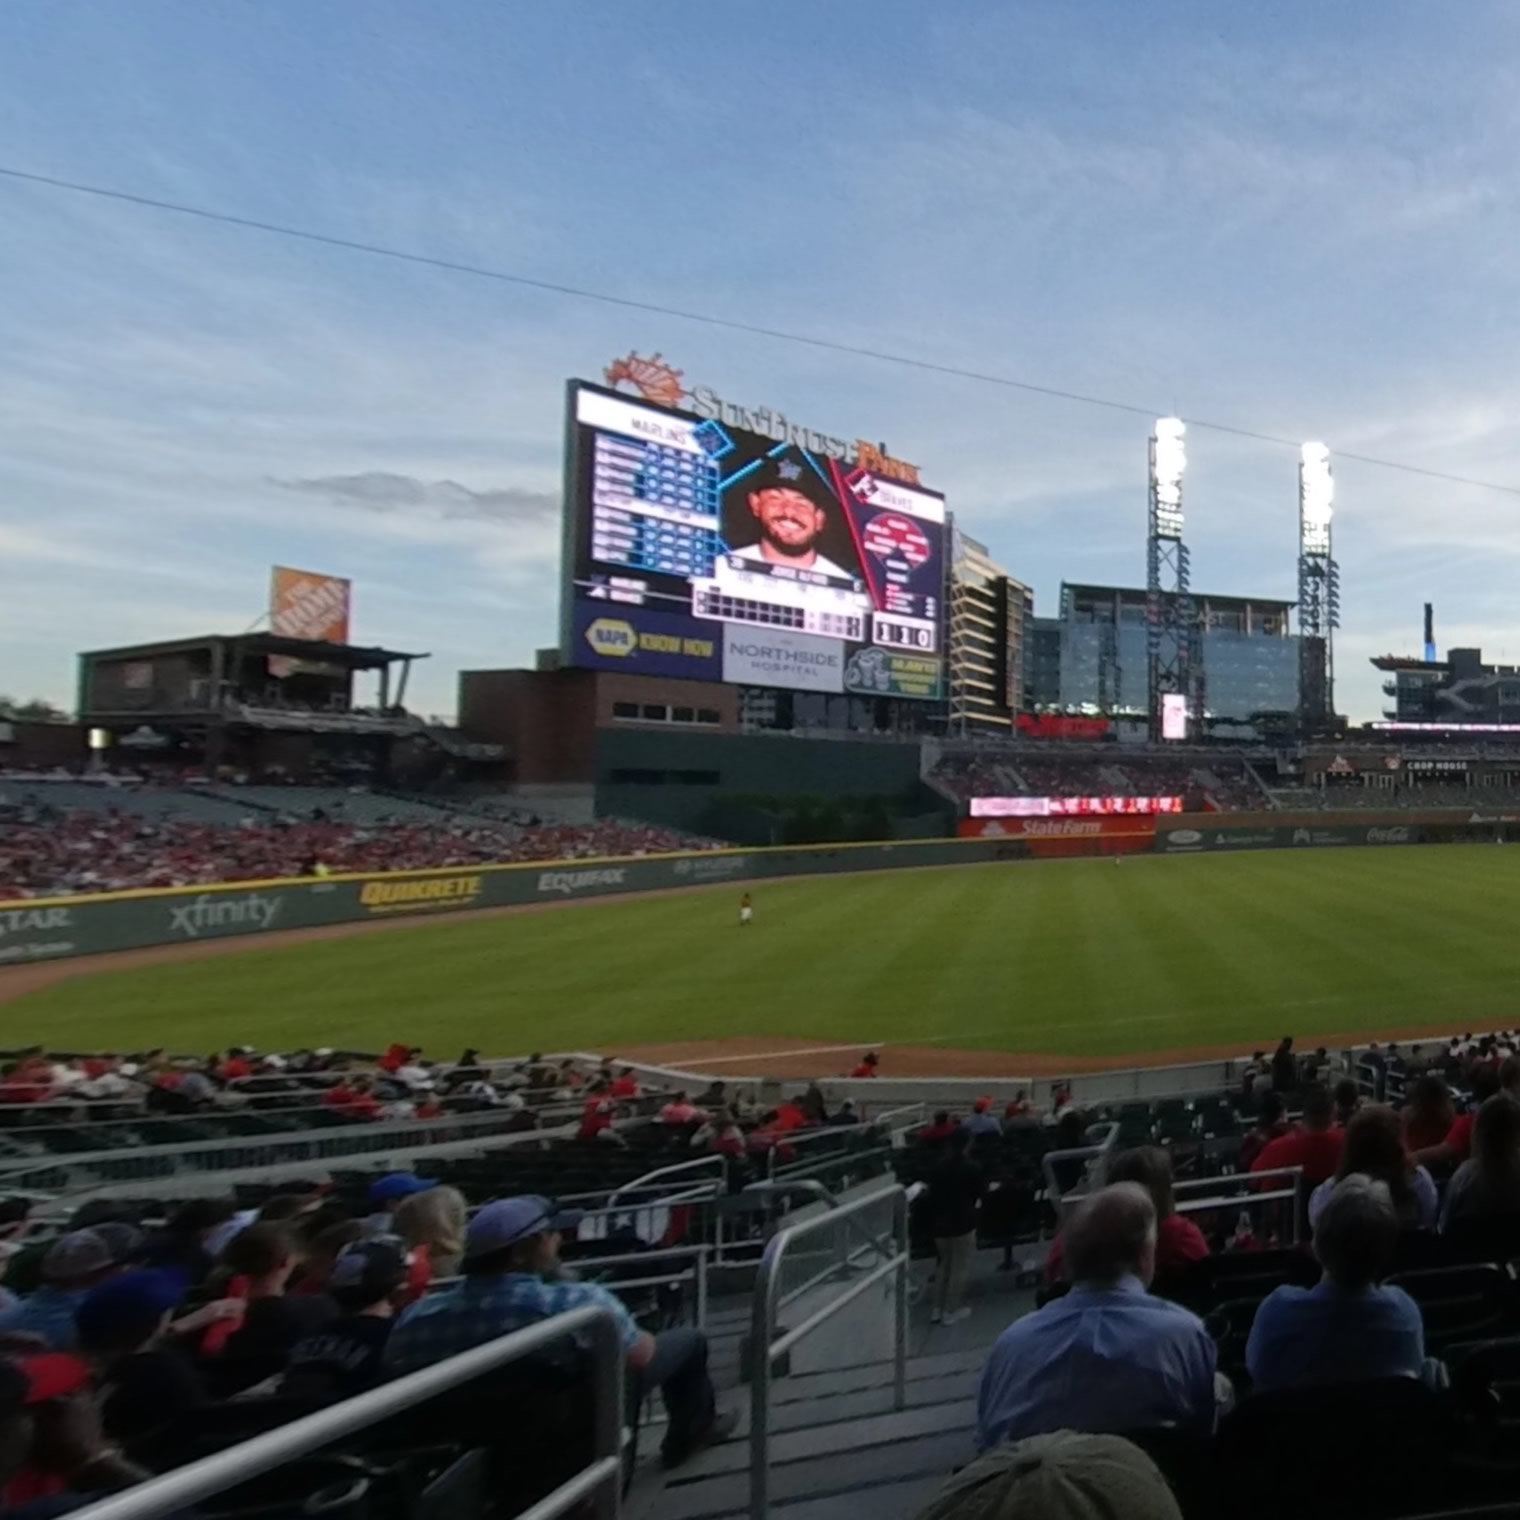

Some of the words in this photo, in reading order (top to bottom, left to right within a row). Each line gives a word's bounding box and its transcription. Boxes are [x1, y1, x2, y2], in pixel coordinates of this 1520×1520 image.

[631, 417, 686, 444] MARLINS
[594, 628, 629, 646] NAPA
[639, 632, 682, 654] KNOW
[683, 638, 714, 658] HOW
[730, 642, 839, 667] NORTHSIDE
[751, 661, 819, 677] HOSPITAL
[1407, 761, 1434, 770] CHOP
[1436, 761, 1468, 770] HOUSE
[360, 875, 482, 905] QUIKRETE
[537, 867, 627, 893] EQUIFAX
[168, 893, 282, 936] xfinity
